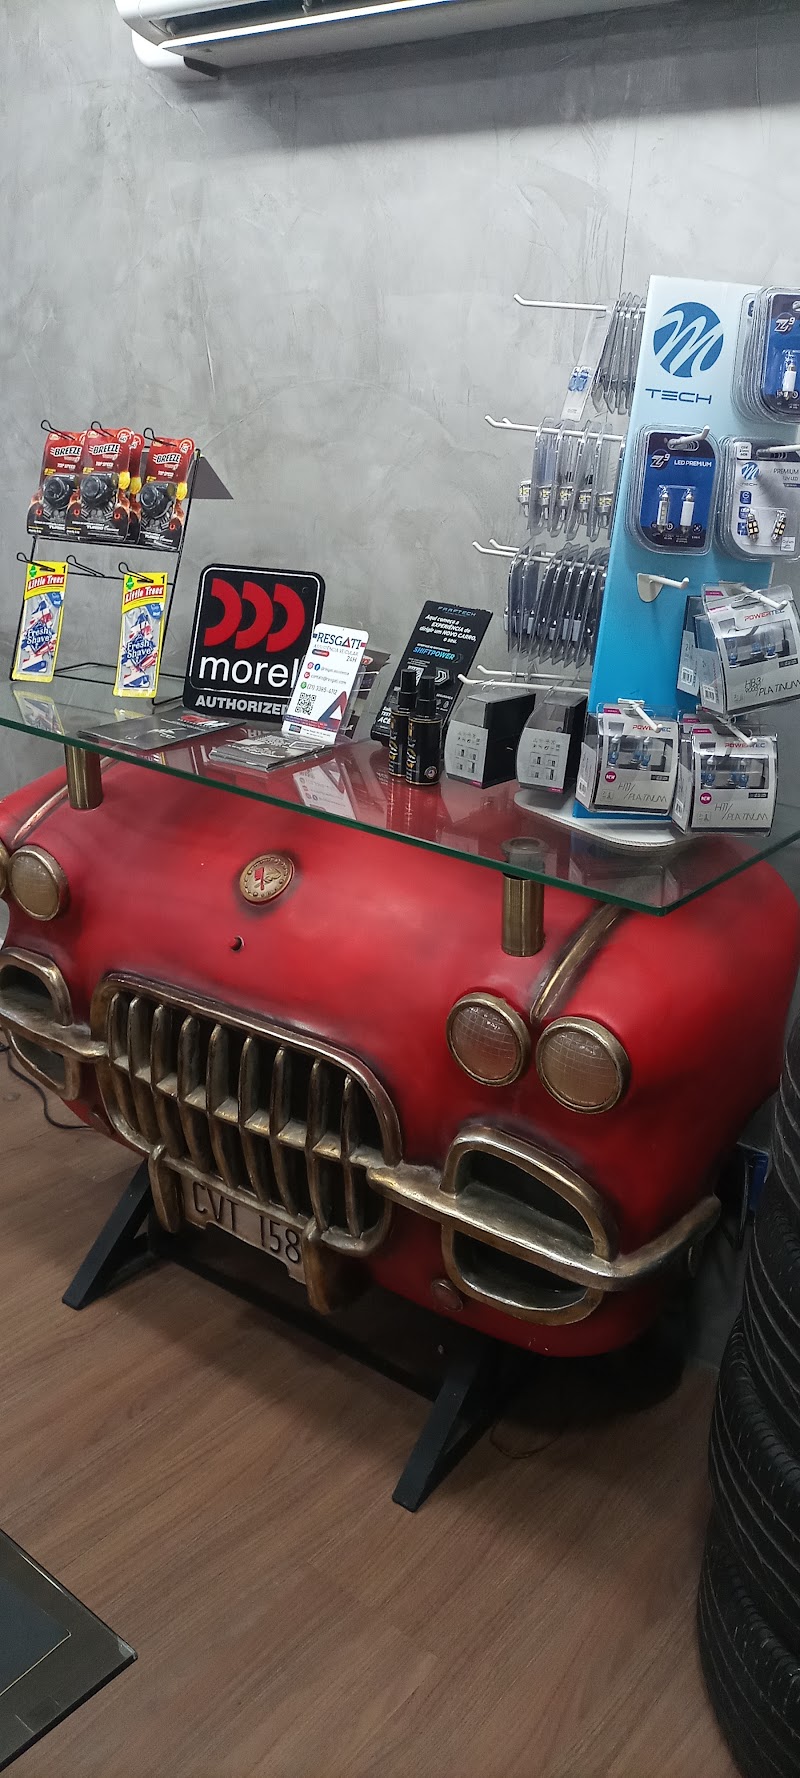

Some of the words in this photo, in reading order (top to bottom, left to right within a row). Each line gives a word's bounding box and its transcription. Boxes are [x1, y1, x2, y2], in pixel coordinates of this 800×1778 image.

[645, 388, 712, 404] TECH
[54, 446, 82, 456] BREEZE
[93, 444, 120, 454] BREEZE
[156, 453, 181, 463] BREEZE
[62, 565, 66, 573] 1
[28, 577, 46, 590] Little
[46, 575, 64, 584] Trees
[160, 575, 165, 584] 1
[125, 588, 144, 602] Little
[145, 586, 164, 596] Trees
[27, 626, 50, 637] Fresh
[431, 622, 464, 632] EXPERIÊNCIA
[27, 635, 50, 645] Shave
[127, 640, 150, 651] Fresh
[127, 647, 152, 659] Shave
[413, 646, 455, 660] SHIFTPOWER
[199, 655, 299, 689] morel
[193, 1181, 238, 1231] CVT
